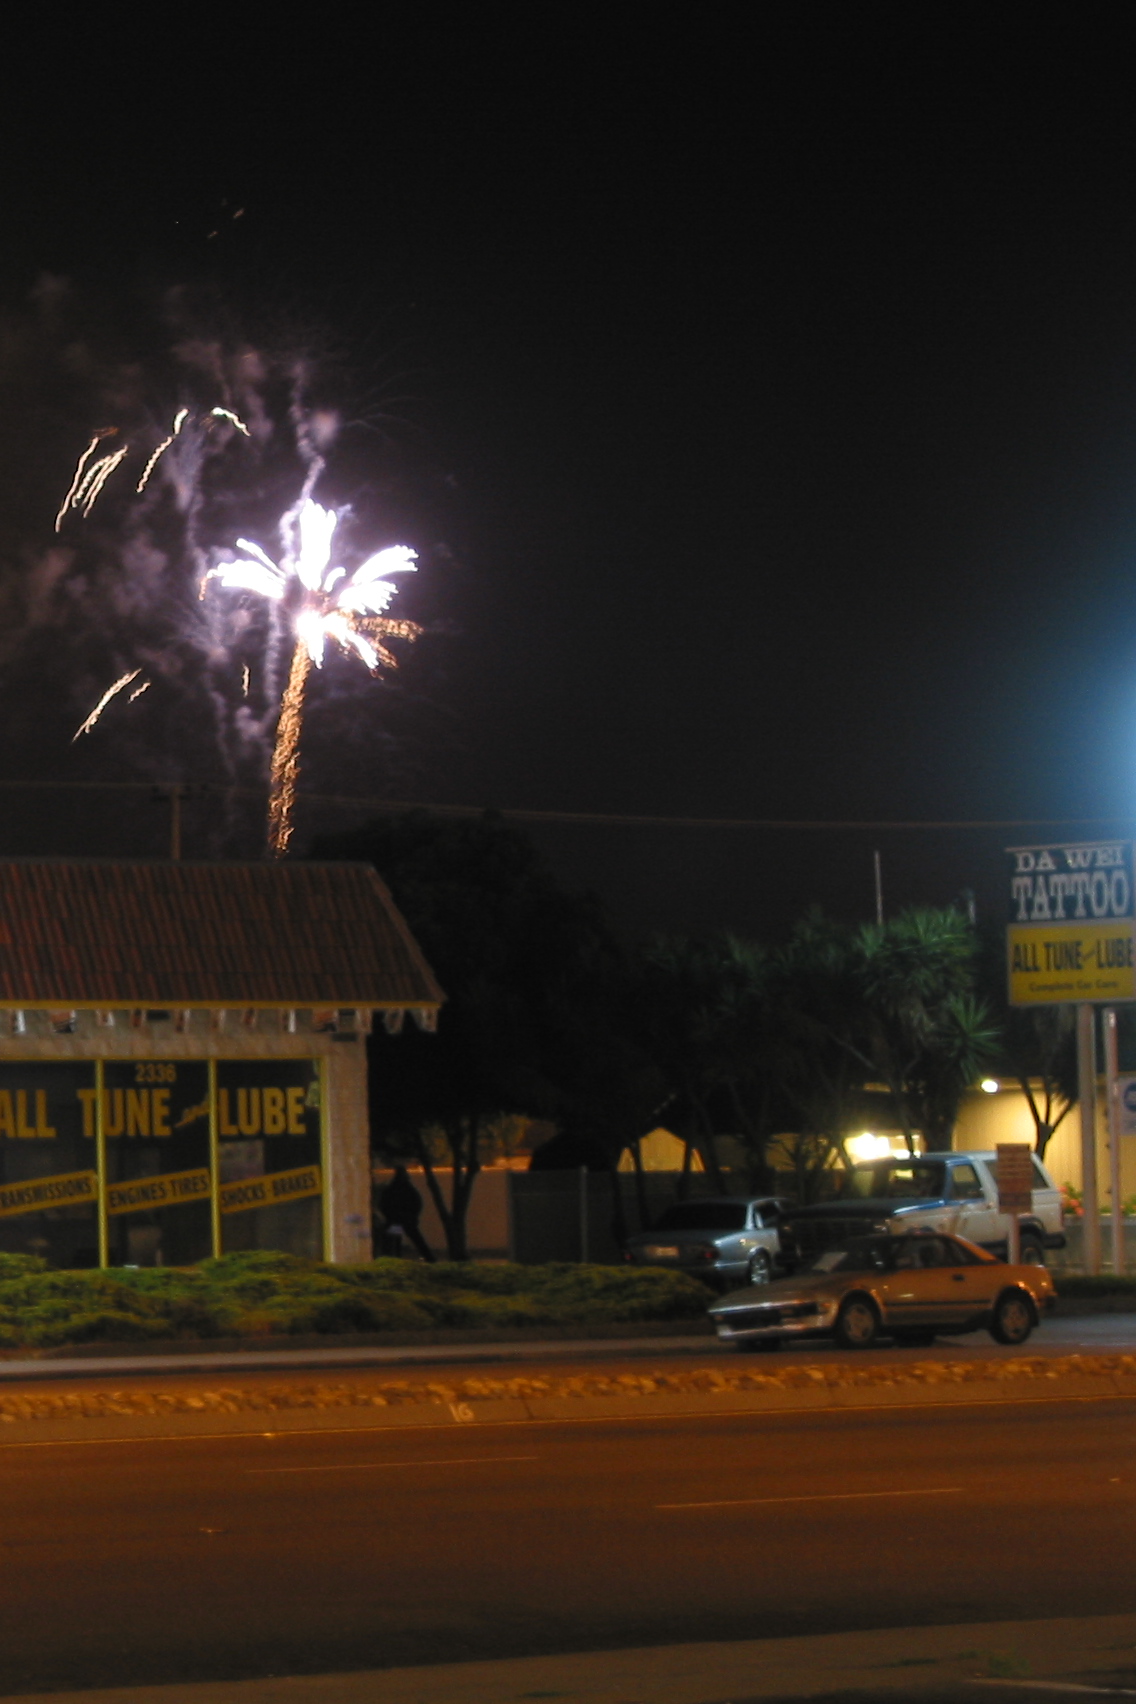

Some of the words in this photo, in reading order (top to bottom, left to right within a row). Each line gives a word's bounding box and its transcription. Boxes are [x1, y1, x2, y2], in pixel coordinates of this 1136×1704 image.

[1016, 851, 1056, 872] DA
[1014, 869, 1130, 920] TATTOO
[1012, 942, 1041, 973] ALL
[1043, 940, 1084, 972] TUNE
[77, 1088, 172, 1137] TUNE
[219, 1086, 307, 1135] LUBE
